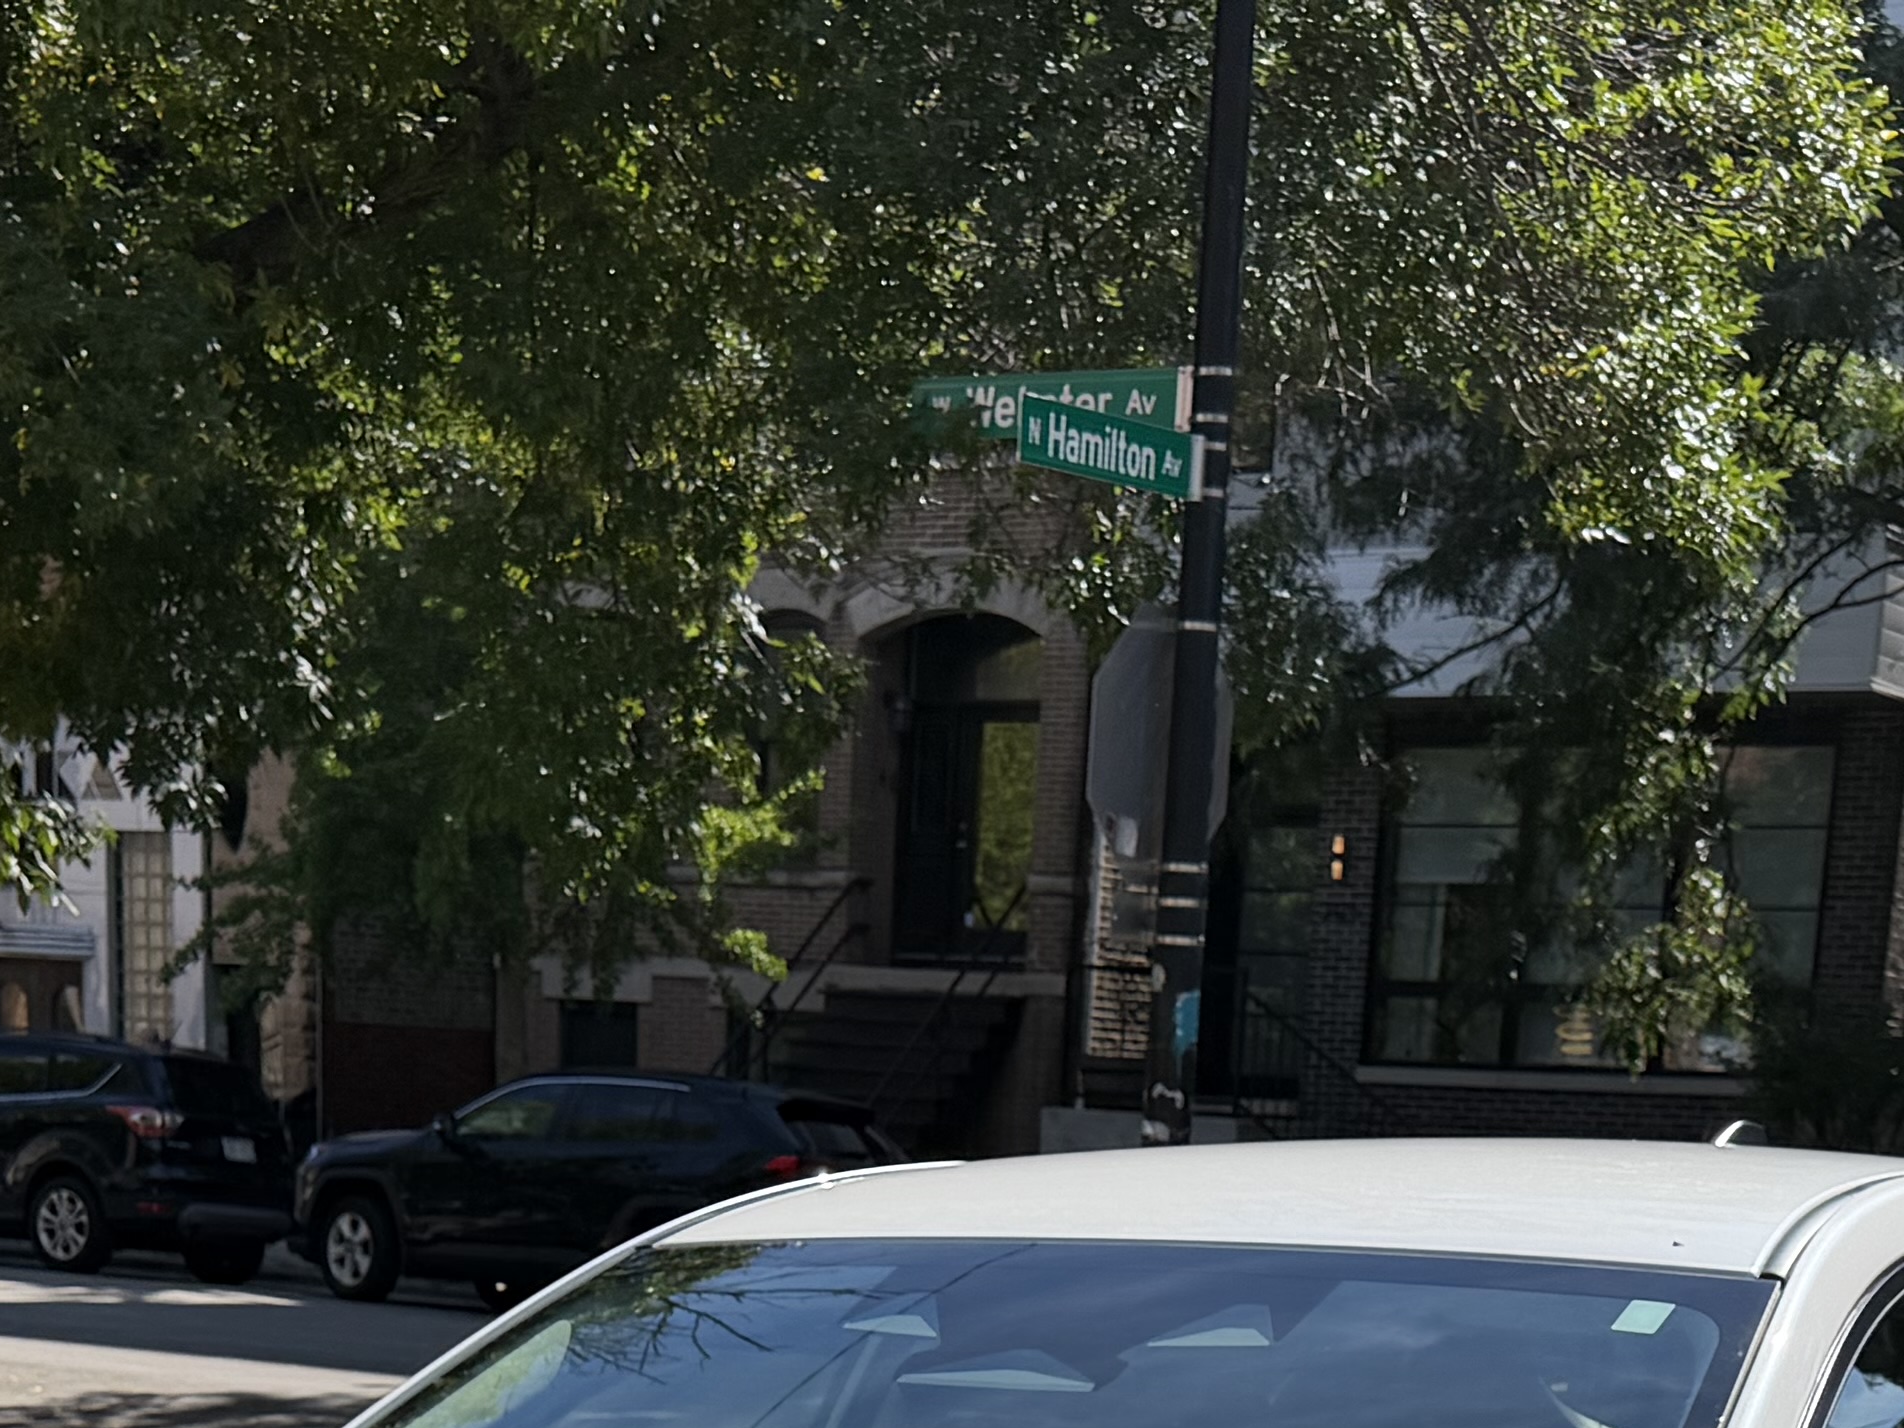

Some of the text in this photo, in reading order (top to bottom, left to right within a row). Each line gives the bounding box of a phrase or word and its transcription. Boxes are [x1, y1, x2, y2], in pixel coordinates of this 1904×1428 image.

[967, 384, 1112, 428] Weter
[1125, 389, 1157, 415] Av
[1028, 412, 1183, 480] N Hamilton Av
